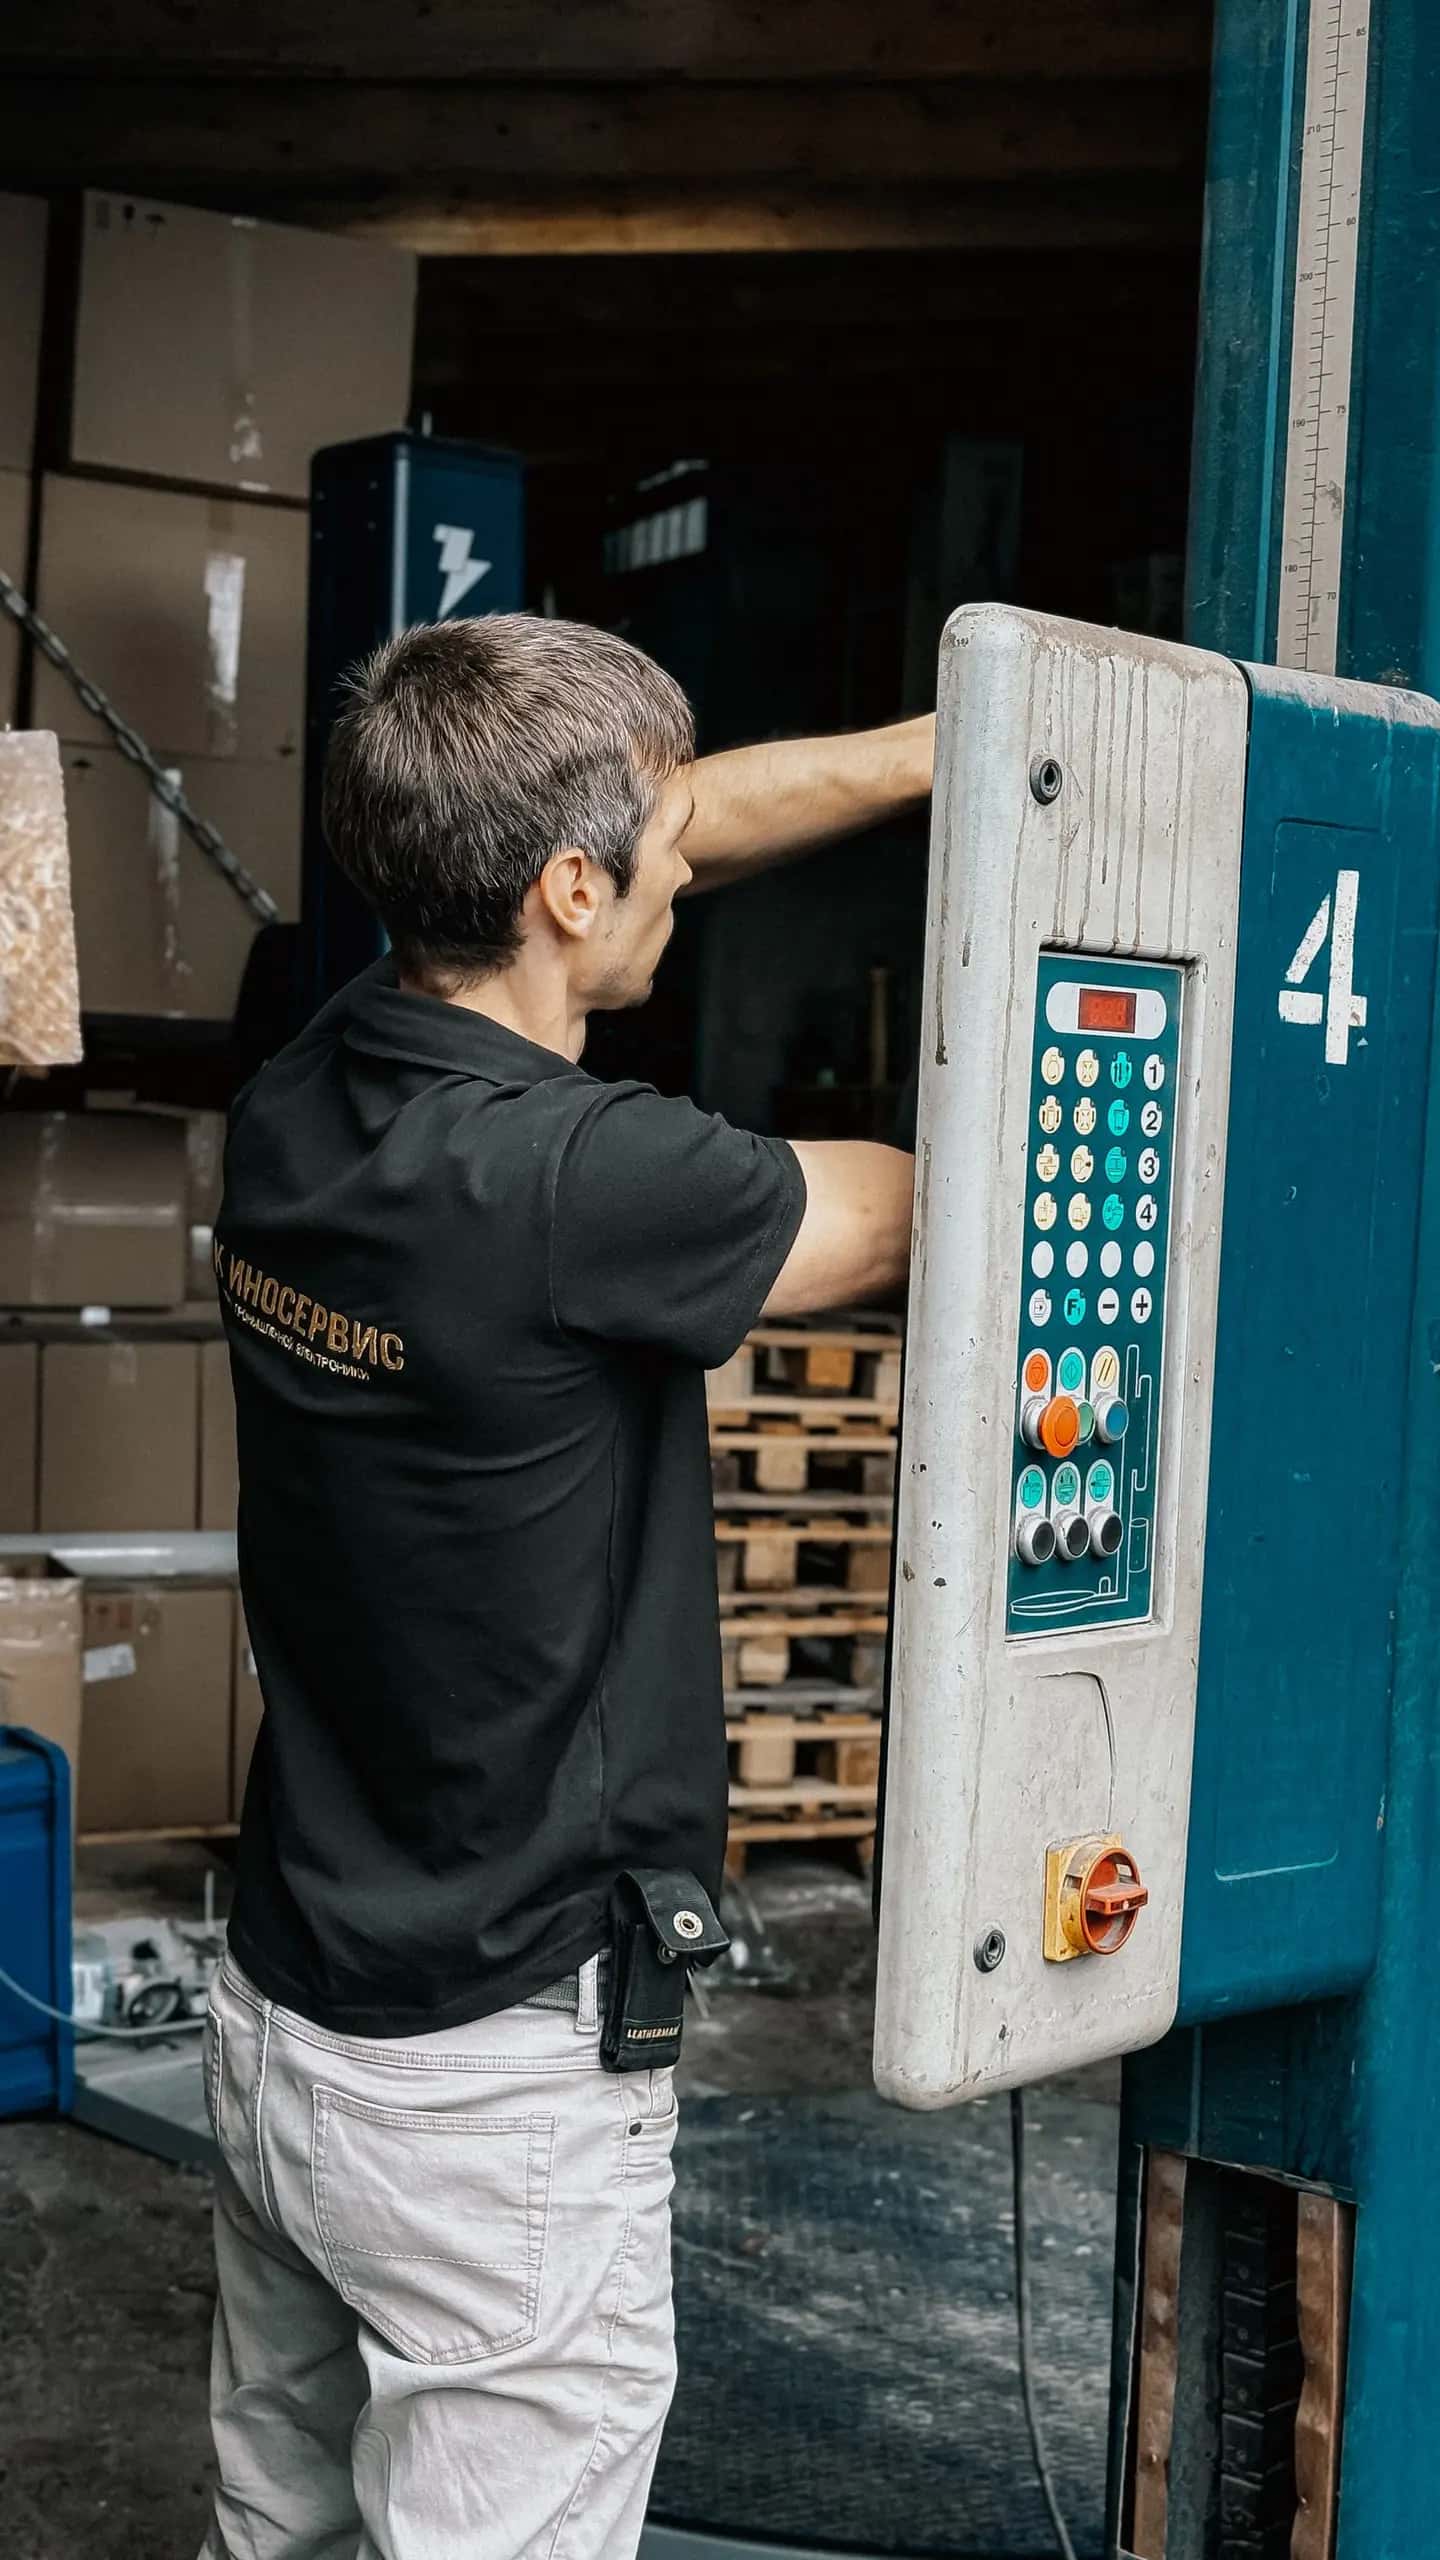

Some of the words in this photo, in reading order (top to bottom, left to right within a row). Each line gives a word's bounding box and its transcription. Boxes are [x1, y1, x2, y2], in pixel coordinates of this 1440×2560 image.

[1299, 273, 1312, 282] 200
[1336, 405, 1345, 414] 75
[1327, 592, 1336, 600] 70
[1278, 869, 1368, 1065] 4
[1148, 1063, 1158, 1084] 1
[1146, 1110, 1158, 1131] 2
[1143, 1156, 1155, 1178] 3
[1140, 1203, 1152, 1224] 4
[229, 1252, 405, 1371] ИНОСЕРВИС
[627, 2025, 680, 2039] LEATHERMAN
